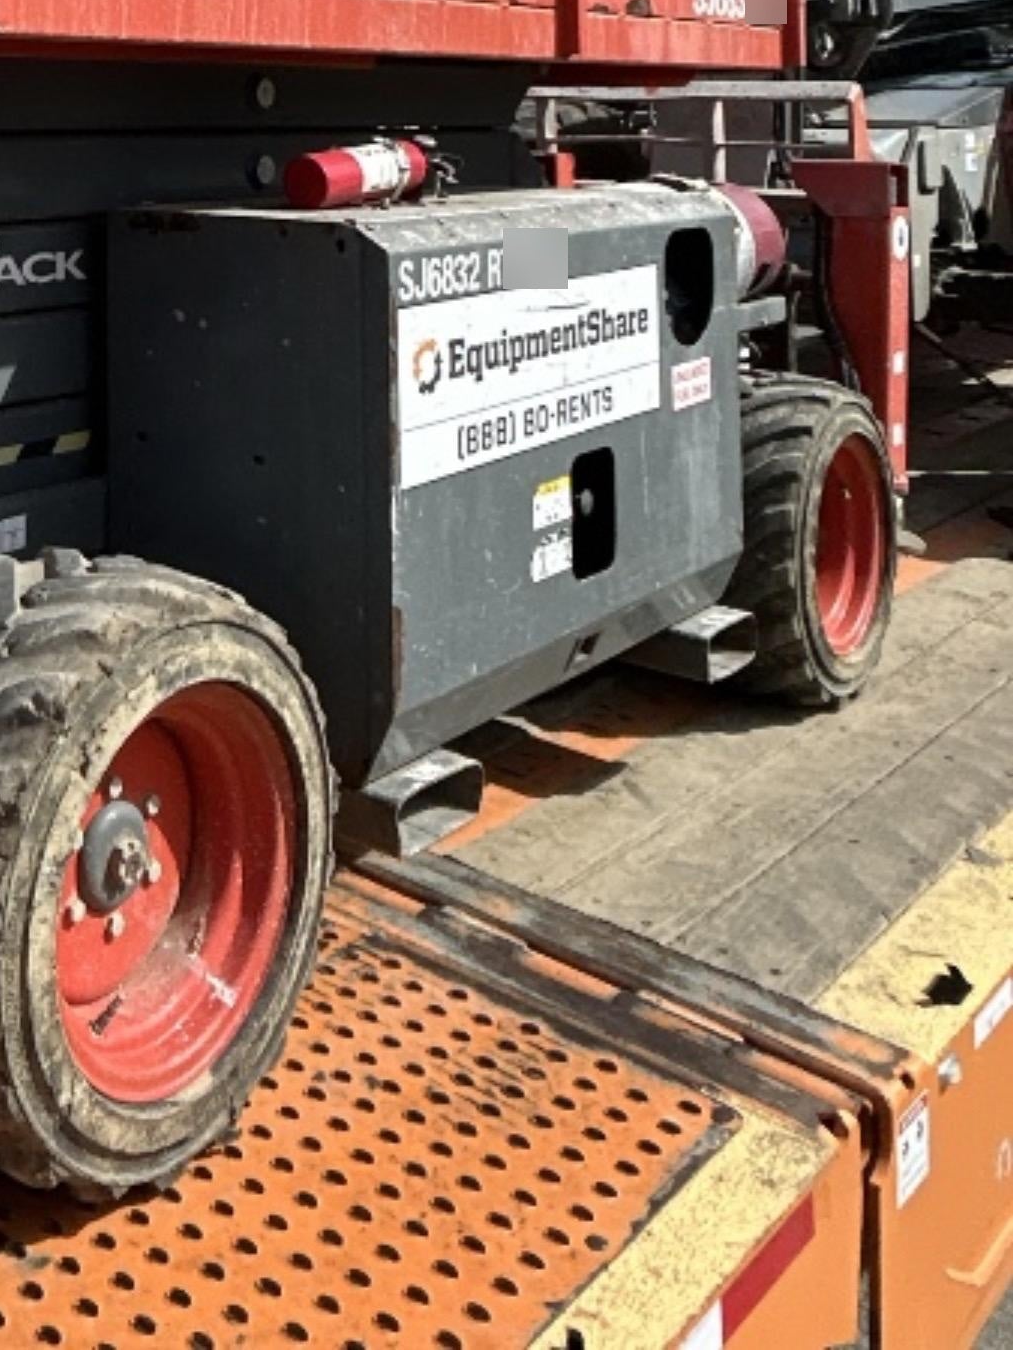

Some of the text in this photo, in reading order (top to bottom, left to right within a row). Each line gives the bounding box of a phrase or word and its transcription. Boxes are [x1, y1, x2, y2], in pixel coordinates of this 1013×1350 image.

[398, 248, 504, 301] SJ6832 R
[448, 308, 649, 382] EquipmentShare
